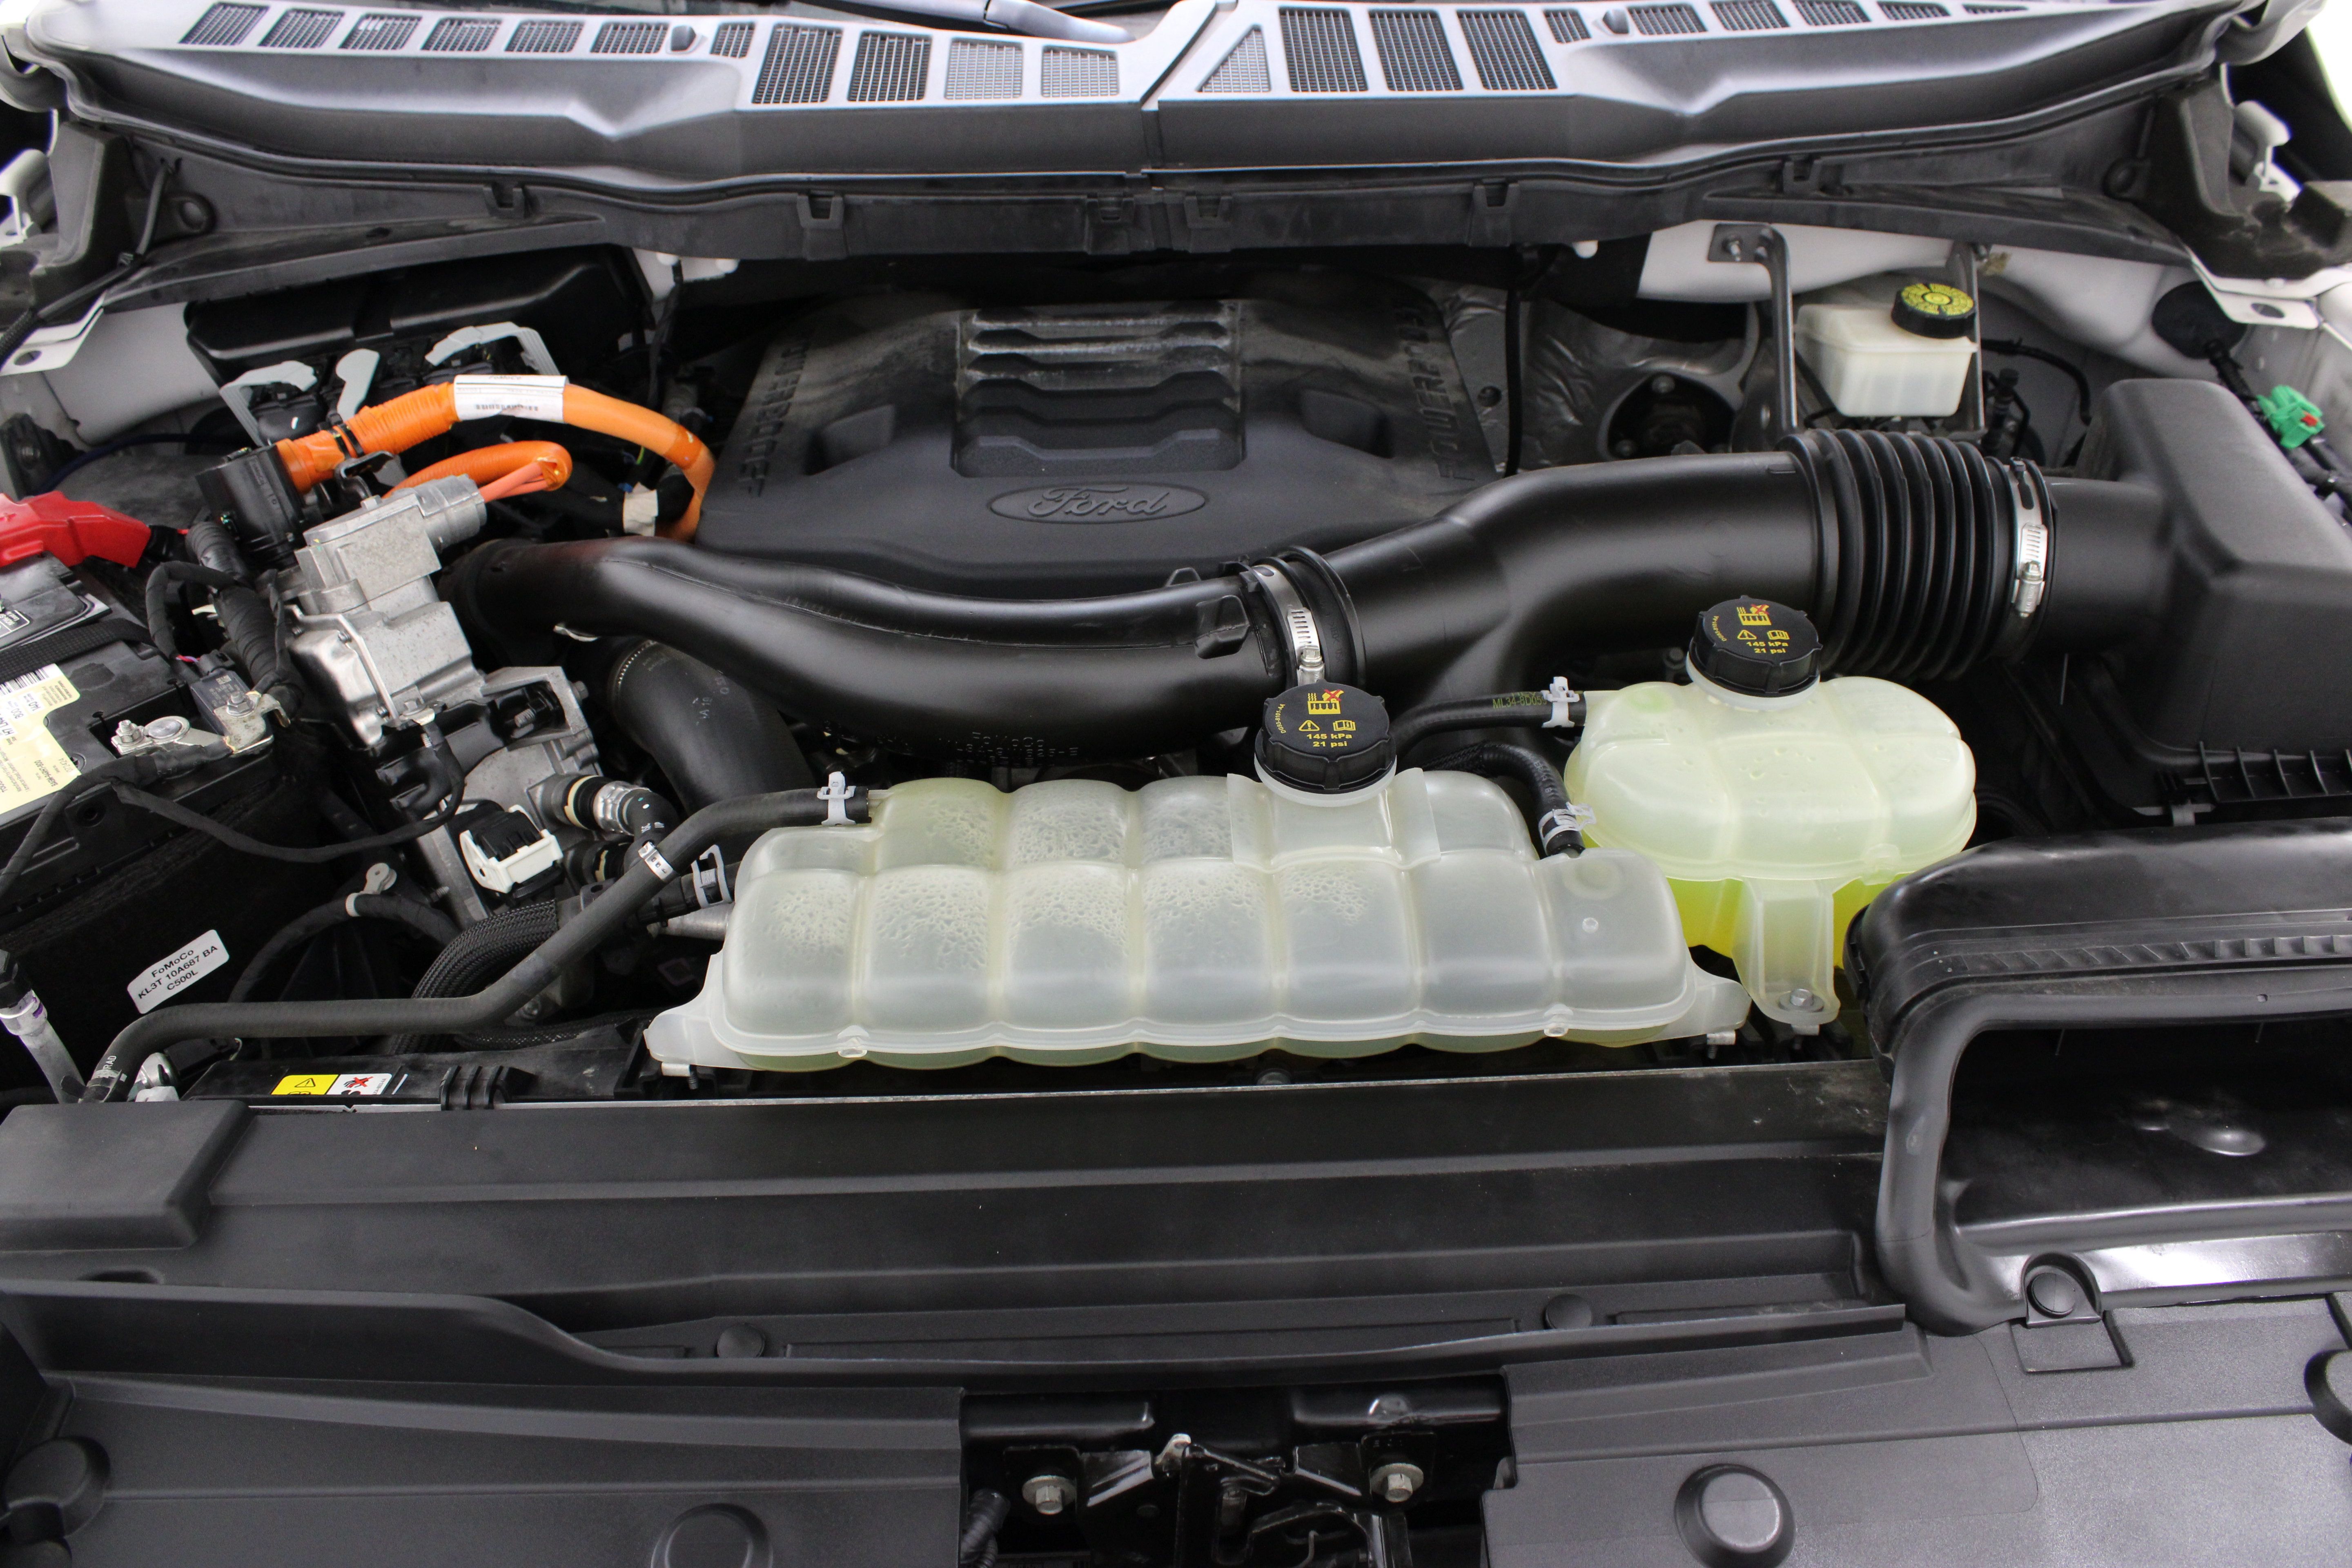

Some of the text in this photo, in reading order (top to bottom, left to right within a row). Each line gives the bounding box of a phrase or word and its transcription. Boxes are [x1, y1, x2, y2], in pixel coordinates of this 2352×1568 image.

[1027, 486, 1170, 517] Ford
[11, 708, 24, 719] 800
[29, 702, 40, 711] 140
[1275, 704, 1287, 734] DG93-8101-AA
[58, 758, 74, 773] 072424
[138, 946, 218, 999] KL3T 10A687 BA
[151, 950, 194, 978] FoMoCo
[167, 969, 198, 991] C500L
[103, 1056, 117, 1069] RAD
